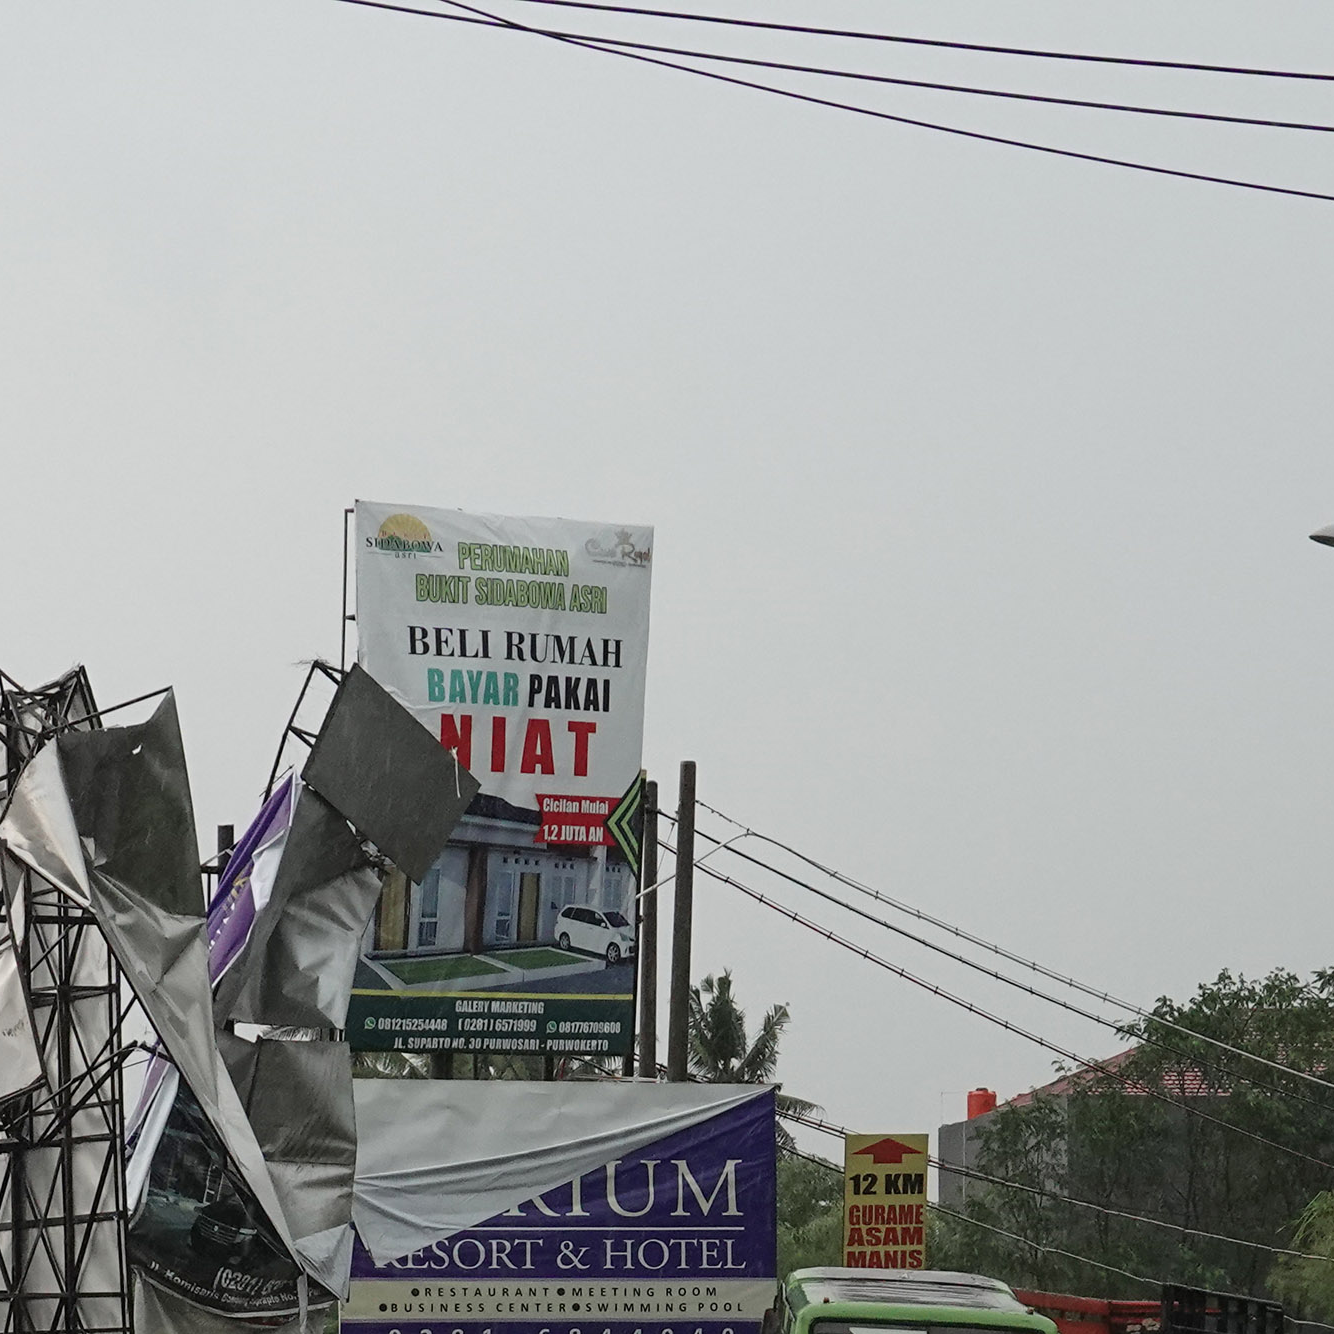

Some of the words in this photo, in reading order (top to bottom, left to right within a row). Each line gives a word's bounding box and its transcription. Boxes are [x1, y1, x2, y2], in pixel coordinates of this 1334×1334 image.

[366, 537, 444, 553] SIDABOWA
[457, 541, 569, 577] PERUMAHAN
[415, 573, 471, 604] BUKIT
[474, 576, 566, 611] SIDABOWA
[569, 583, 608, 614] ASRI
[407, 625, 491, 659] BELI
[504, 630, 623, 668] RUMAH
[427, 668, 519, 707] BAYAR
[527, 674, 610, 712] PAKAI
[440, 713, 597, 777] NIAT
[543, 797, 579, 813] Cicilan
[581, 799, 608, 815] Mulai
[543, 824, 559, 842] 1,2
[455, 1000, 488, 1013] GALERY
[490, 1001, 545, 1014] MARKETING
[393, 1037, 406, 1049] JL.
[483, 1038, 540, 1050] PURWOSARI
[546, 1040, 609, 1051] PURWOKERTO
[849, 1173, 878, 1195] 12
[885, 1173, 924, 1195] KM
[849, 1204, 924, 1225] GURAME
[847, 1227, 923, 1246] ASAM
[556, 1240, 591, 1270] &
[603, 1238, 747, 1270] HOTEL
[847, 1250, 923, 1269] MANIS
[424, 1287, 551, 1297] RESTAURANT
[572, 1287, 655, 1297] MEETING
[666, 1287, 717, 1297] ROOM
[390, 1303, 485, 1313] BUSINESS
[496, 1303, 567, 1313] CENTER
[585, 1302, 687, 1313] SWIMMING
[698, 1302, 743, 1312] POOL
